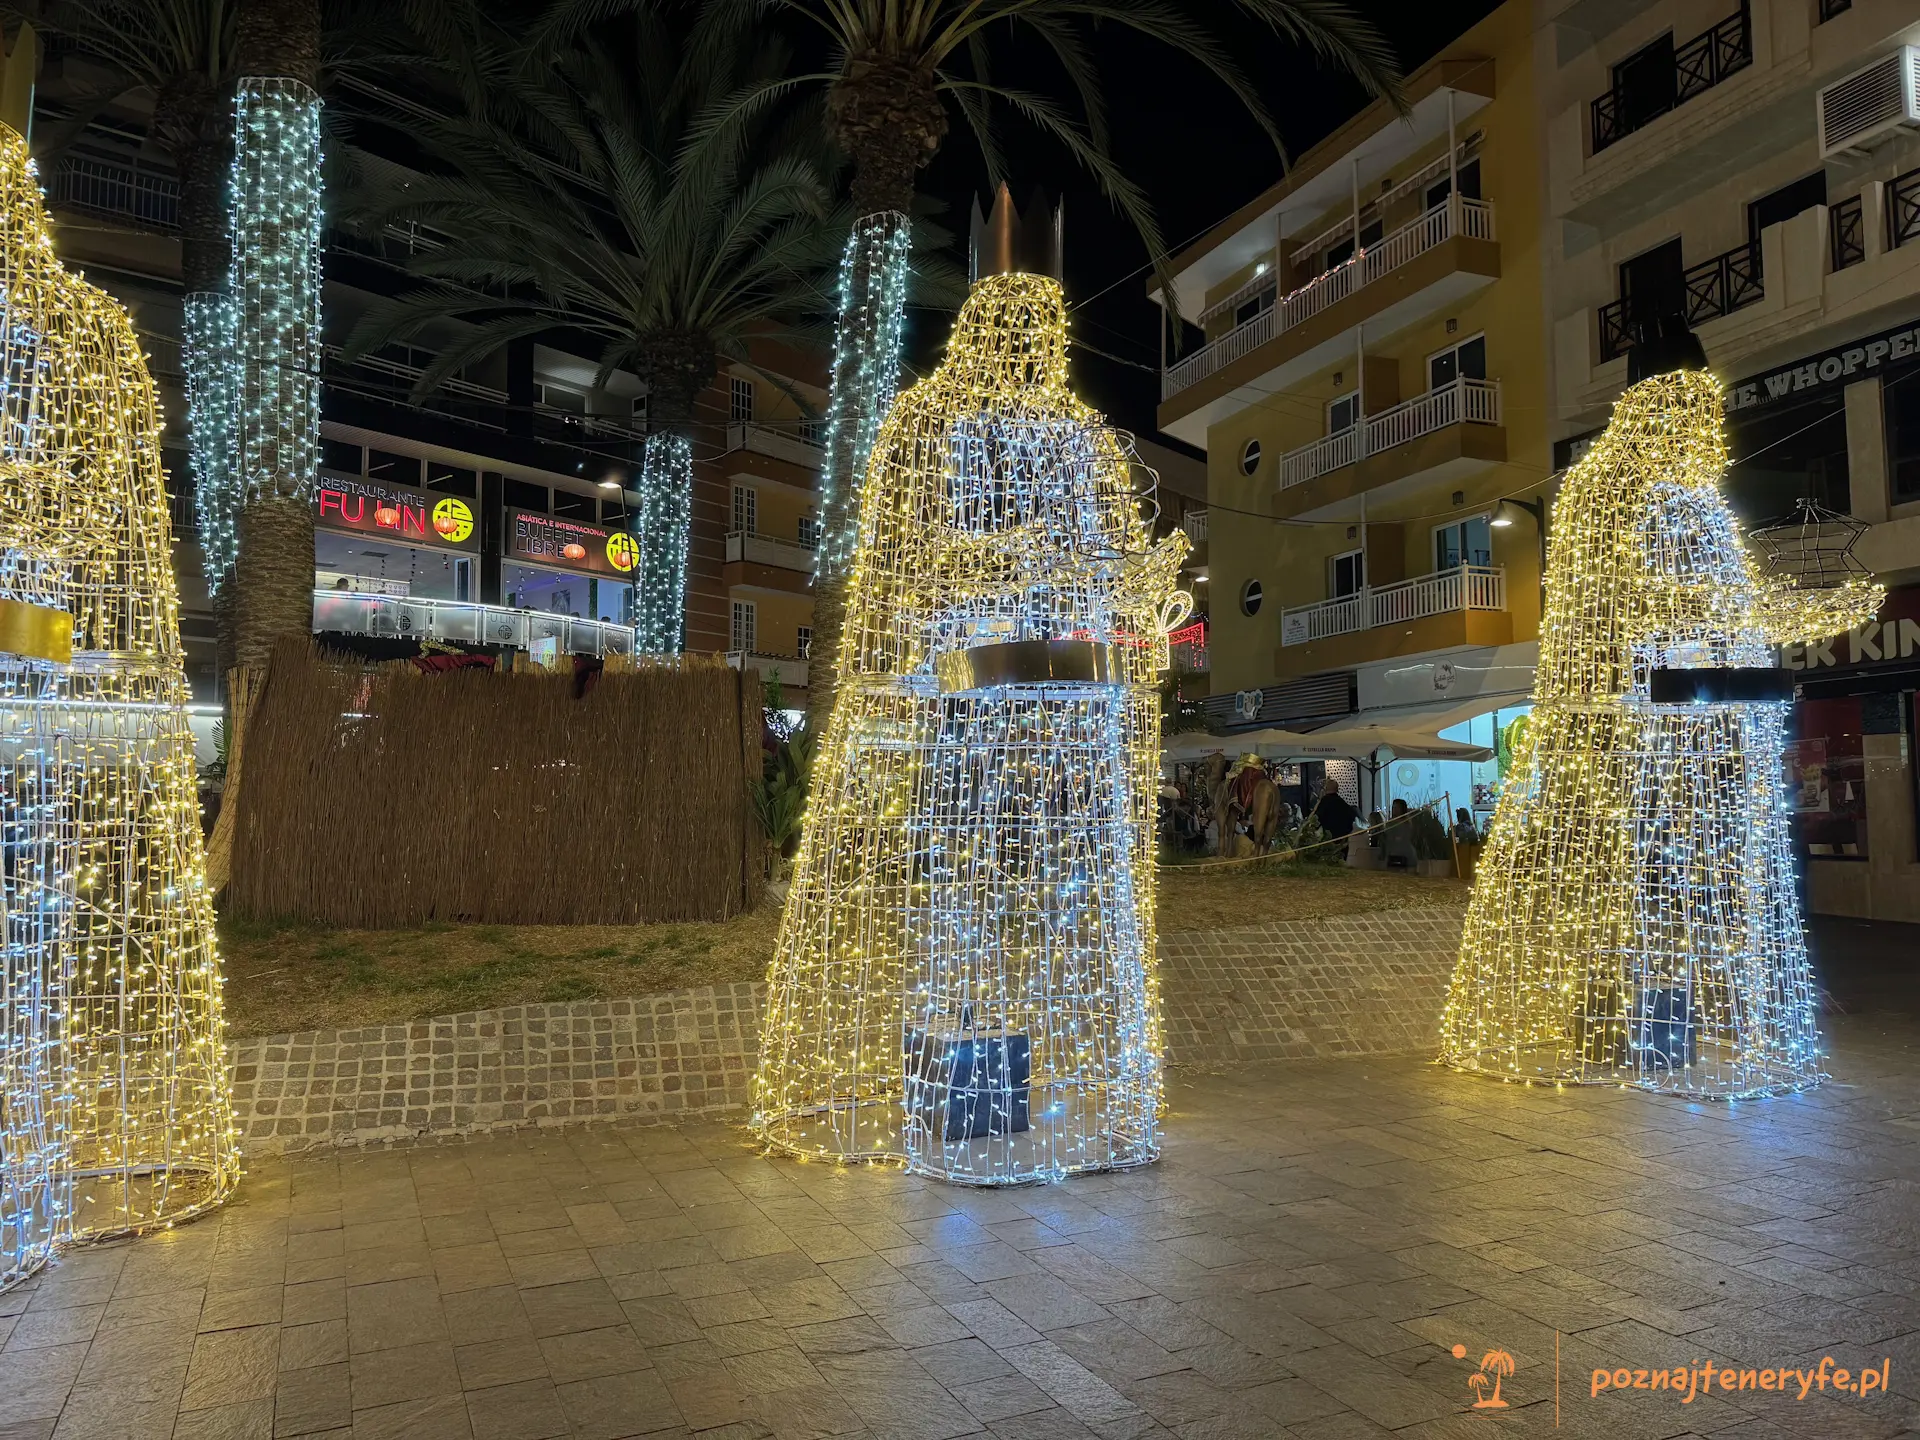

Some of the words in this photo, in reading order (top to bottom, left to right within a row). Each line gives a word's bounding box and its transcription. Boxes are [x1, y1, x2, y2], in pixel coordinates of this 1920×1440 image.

[1723, 382, 1757, 413] HE
[1764, 328, 1920, 398] WHOPPE
[320, 476, 425, 507] RESTAURANTE
[320, 489, 365, 523] FU
[376, 500, 425, 534] LIN
[516, 513, 548, 527] ASIÁTICA
[555, 522, 608, 538] INTERNACIONAL
[516, 520, 584, 545] BUFFET
[516, 536, 566, 559] LIBRE
[1781, 636, 1837, 671] ER
